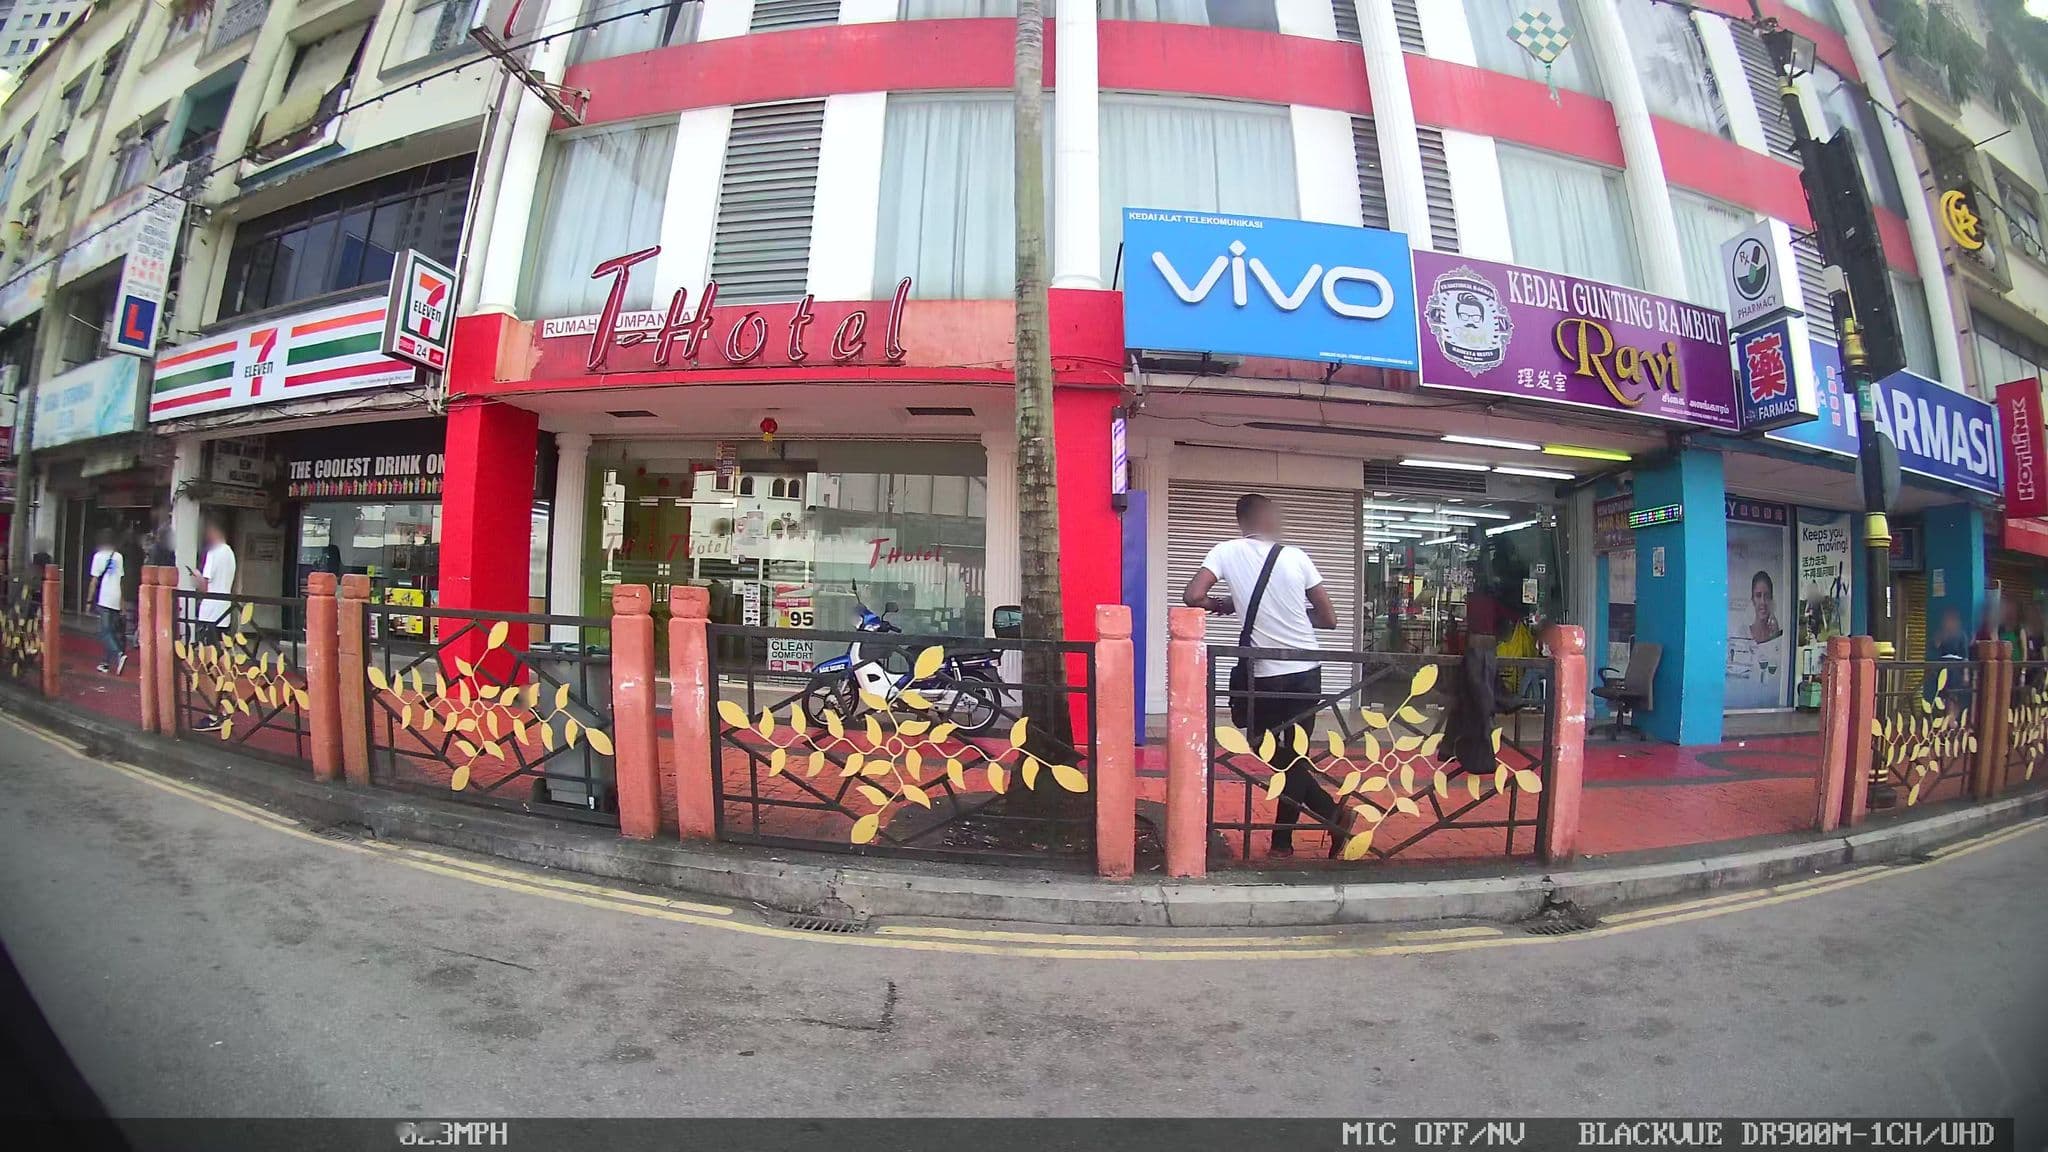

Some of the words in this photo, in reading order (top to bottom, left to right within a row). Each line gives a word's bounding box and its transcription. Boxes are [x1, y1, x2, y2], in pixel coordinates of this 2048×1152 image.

[1129, 211, 1159, 221] KEDAI
[1159, 213, 1182, 223] ALAT
[1183, 215, 1264, 229] TELEKOMUNIKASI
[1151, 239, 1395, 320] vivo
[587, 245, 912, 371] T-Hotel
[1506, 269, 1568, 314] KEDAI
[1573, 282, 1652, 329] GUNTING
[1655, 301, 1723, 346] RAMBUT
[1737, 295, 1776, 319] PHARMACY
[125, 303, 145, 342] L
[416, 344, 427, 357] 24
[1556, 318, 1682, 408] Ravi
[1516, 367, 1568, 392] 理发室
[1758, 398, 1797, 420] FARMASI
[289, 460, 311, 480] THE
[314, 457, 371, 479] COOLEST
[374, 454, 421, 476] DRINK
[1802, 527, 1828, 543] Keeps
[1829, 527, 1844, 542] you
[790, 611, 814, 627] 95
[771, 641, 814, 652] CLEAN
[771, 651, 814, 660] COMFORT
